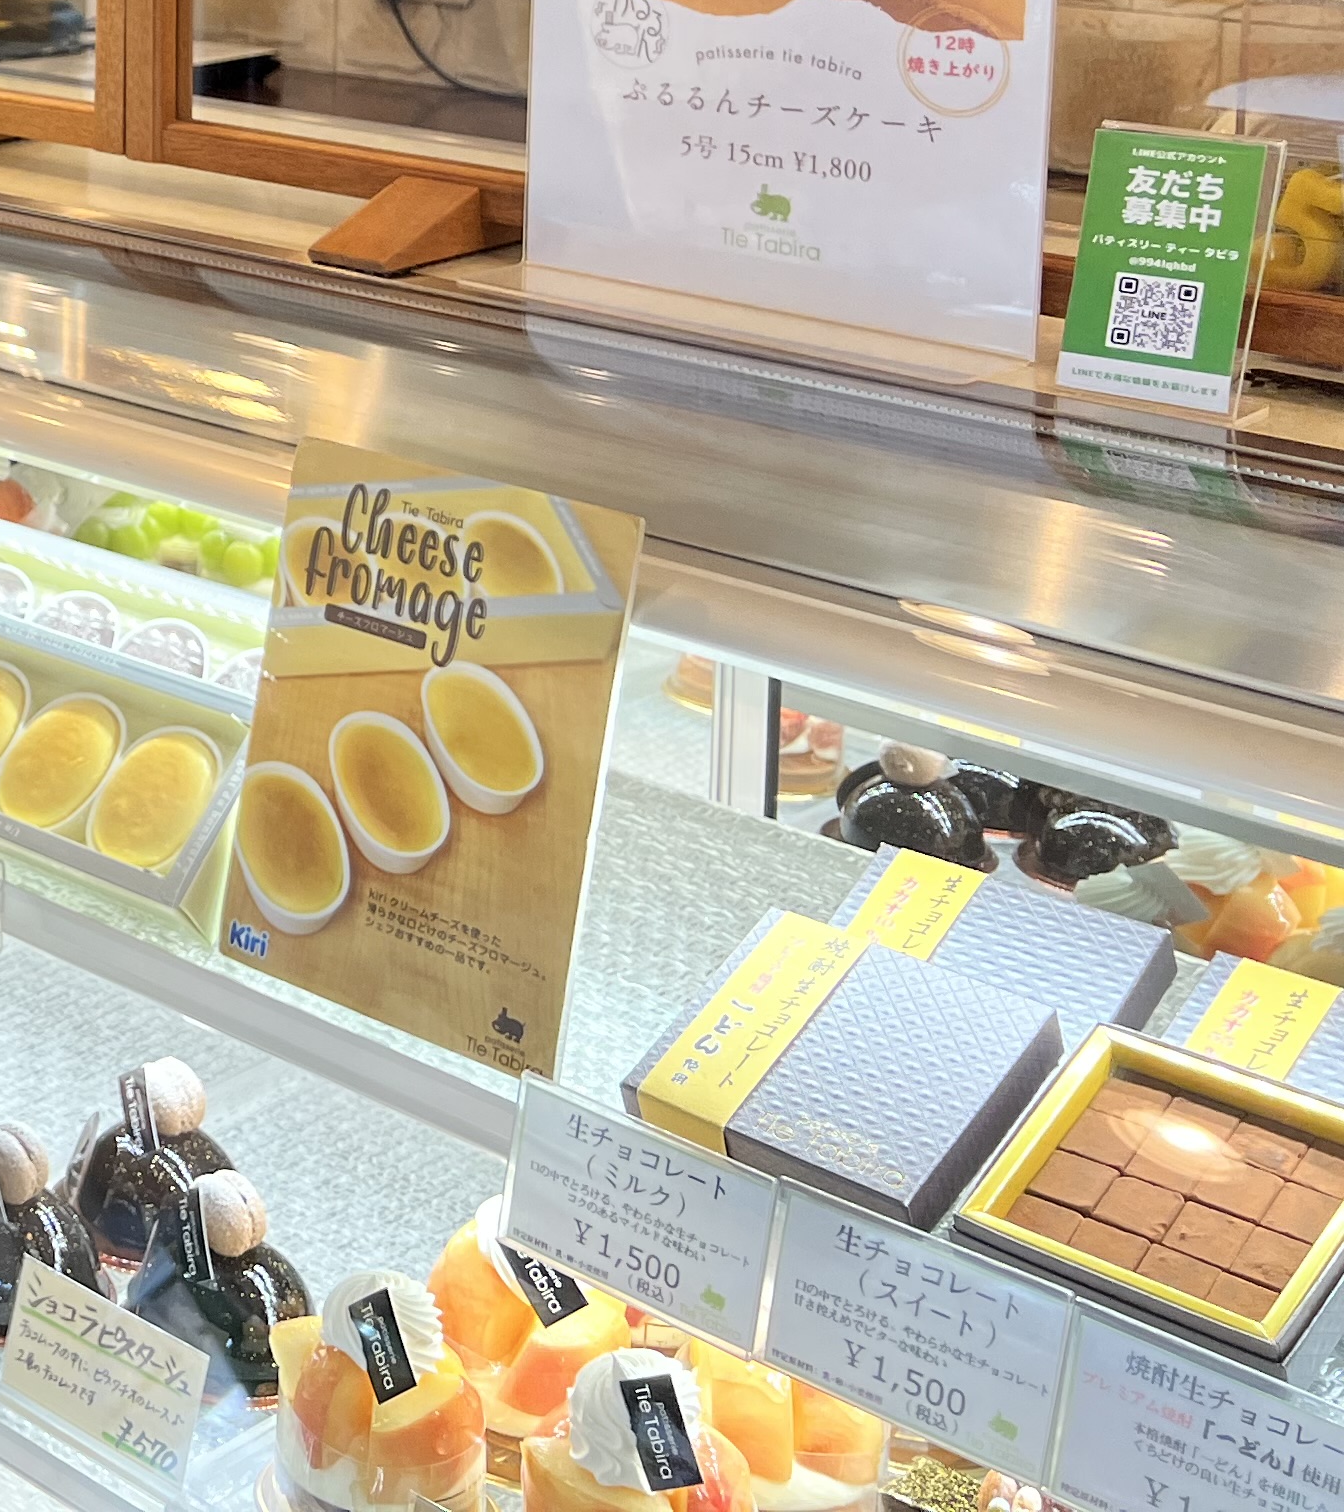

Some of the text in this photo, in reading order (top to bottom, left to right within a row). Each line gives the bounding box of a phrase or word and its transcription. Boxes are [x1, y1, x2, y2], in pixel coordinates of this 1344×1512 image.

[695, 45, 864, 82] patisserie tie tabira
[933, 34, 976, 55] 12時
[906, 56, 996, 82] 焼き上がり
[679, 134, 873, 183] 5号 15cm ¥1,800
[1124, 164, 1225, 202] 友だち
[1121, 194, 1223, 234] 募集中
[720, 226, 822, 263] Tie Tabira
[1091, 233, 1162, 252] パティスリー
[1204, 245, 1240, 262] タビラ
[1140, 308, 1168, 322] LINE
[341, 482, 484, 583] Cheese
[401, 500, 464, 529] Tie Tabira
[304, 525, 488, 668] fromage
[228, 918, 270, 960] Kiri
[466, 1034, 488, 1057] Tie
[566, 1112, 727, 1201] 生チョコレート
[573, 1217, 681, 1290] ¥1,500
[835, 1224, 1020, 1320] 生チョコレート
[523, 1257, 563, 1316] Tabira
[627, 1272, 675, 1307] （税込）
[370, 1330, 395, 1391] Tabira
[843, 1338, 967, 1418] ¥1,500
[115, 1416, 179, 1472] ¥570
[634, 1383, 673, 1481] Tie Tabira
